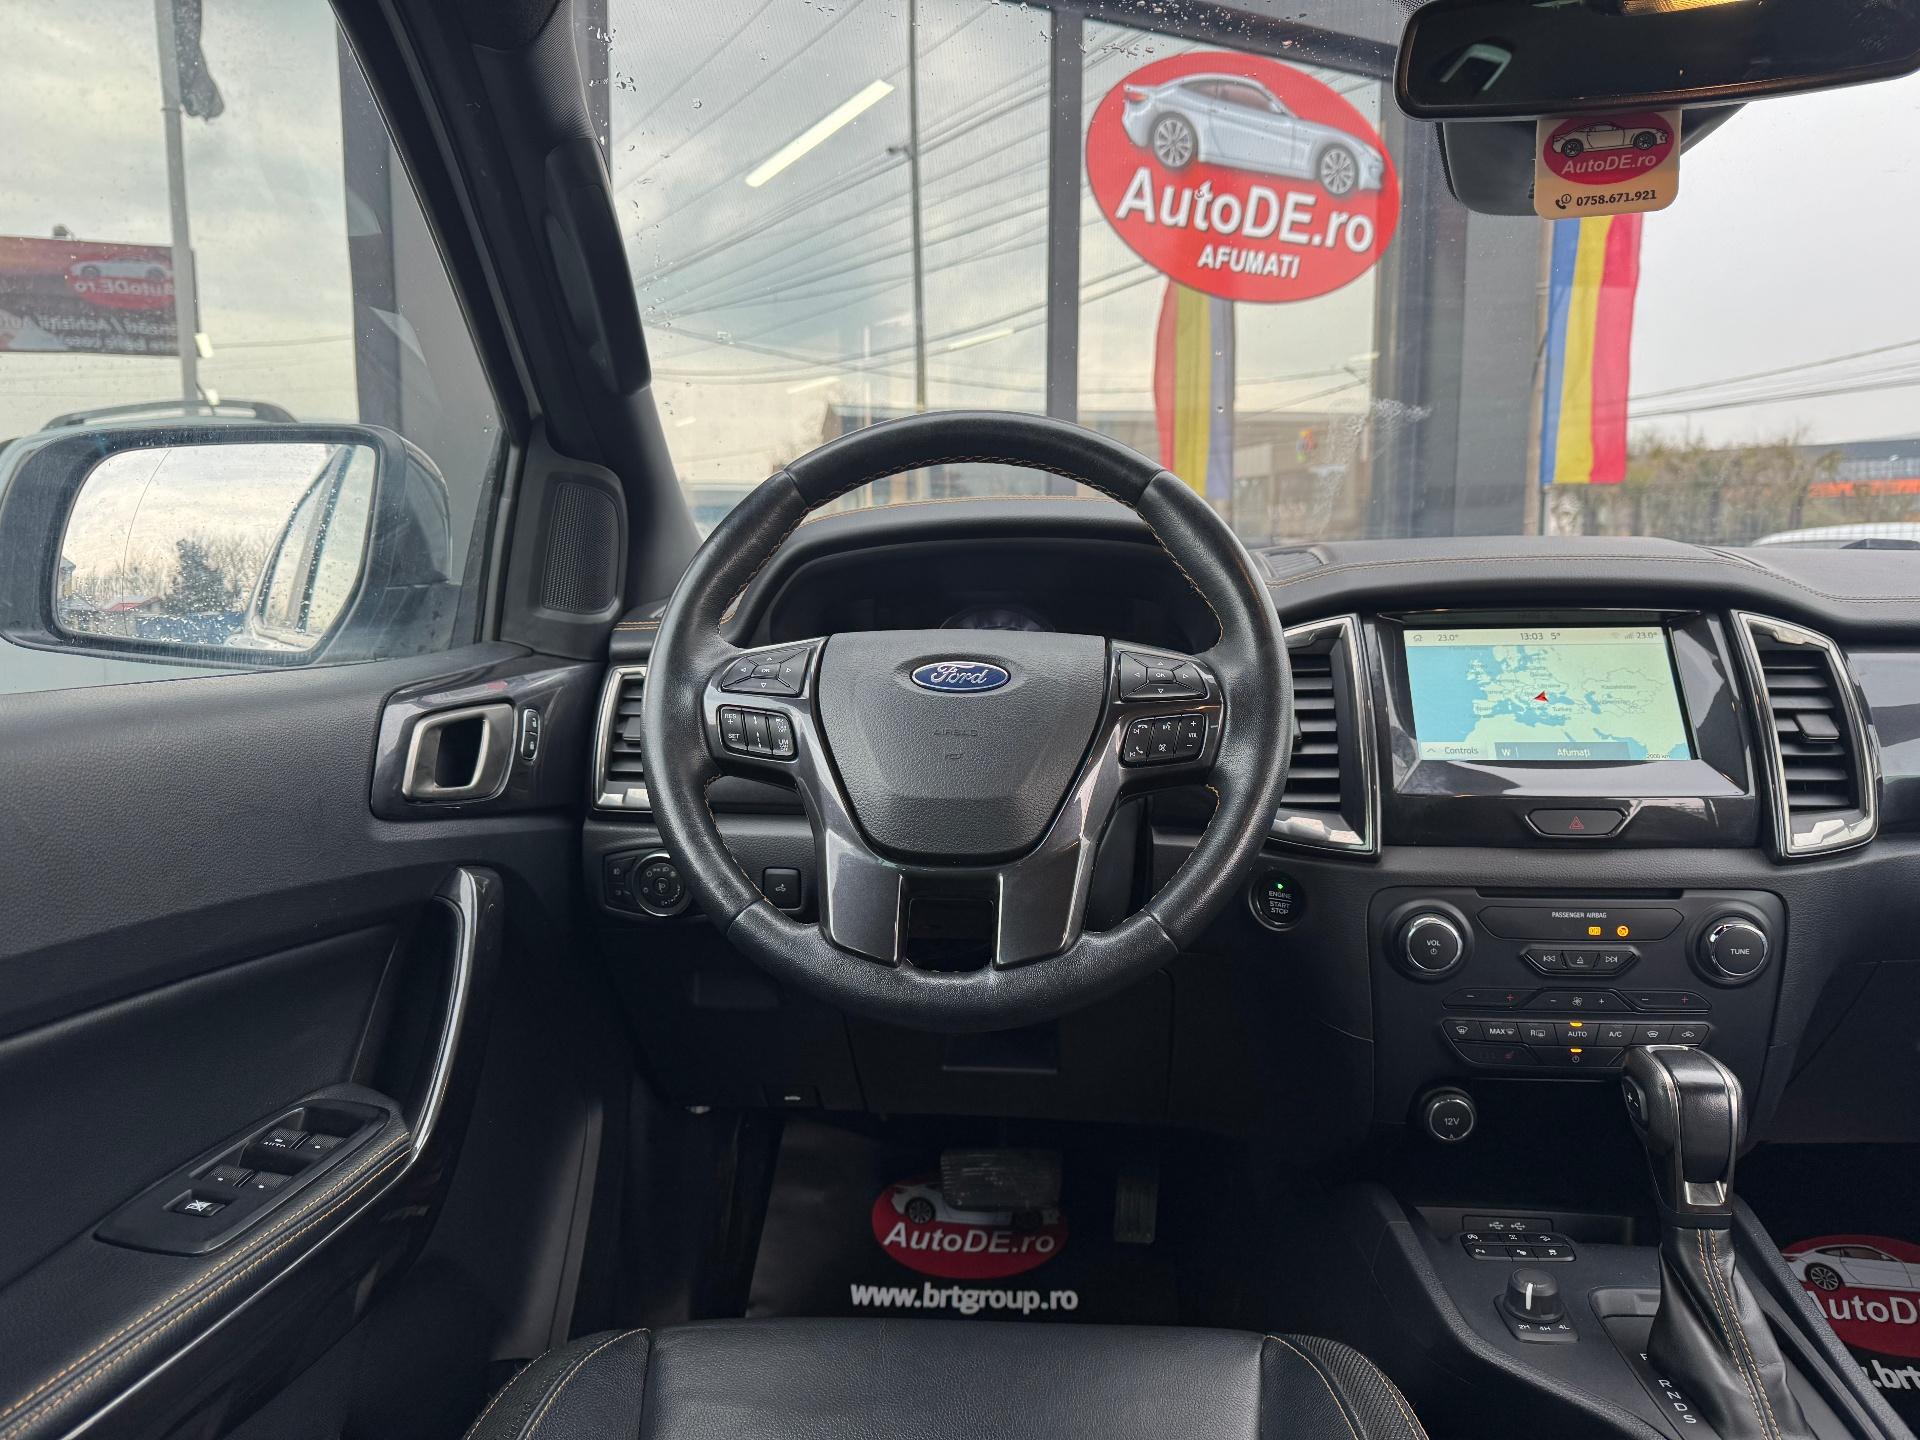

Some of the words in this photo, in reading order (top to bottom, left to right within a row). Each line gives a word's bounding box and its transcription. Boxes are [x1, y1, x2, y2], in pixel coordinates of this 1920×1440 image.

[1561, 154, 1657, 175] AutoDE.ro
[1576, 189, 1657, 207] 0758.671.921
[1115, 166, 1375, 253] AutoDE.ro
[1197, 244, 1301, 279] AFUMATI
[1520, 632, 1544, 641] 13:03
[930, 663, 989, 684] Ford
[1444, 746, 1479, 755] Controls
[1268, 891, 1292, 899] ENGINE
[1269, 900, 1290, 908] START
[1551, 911, 1585, 919] PASSENGER
[1586, 911, 1607, 919] AIRBAG
[1426, 939, 1441, 947] VOL
[1489, 1028, 1506, 1036] MAX
[1567, 1030, 1588, 1038] AUTO
[1608, 1030, 1623, 1038] A/C
[1444, 1117, 1460, 1126] 12V
[882, 1221, 1055, 1253] AutoDE.ro
[850, 1281, 1079, 1316] www.brtgroup.ro
[1807, 1290, 1920, 1325] utoD
[1658, 1379, 1673, 1388] R
[1666, 1391, 1682, 1400] N
[1673, 1402, 1688, 1412] D
[1682, 1414, 1697, 1424] S
